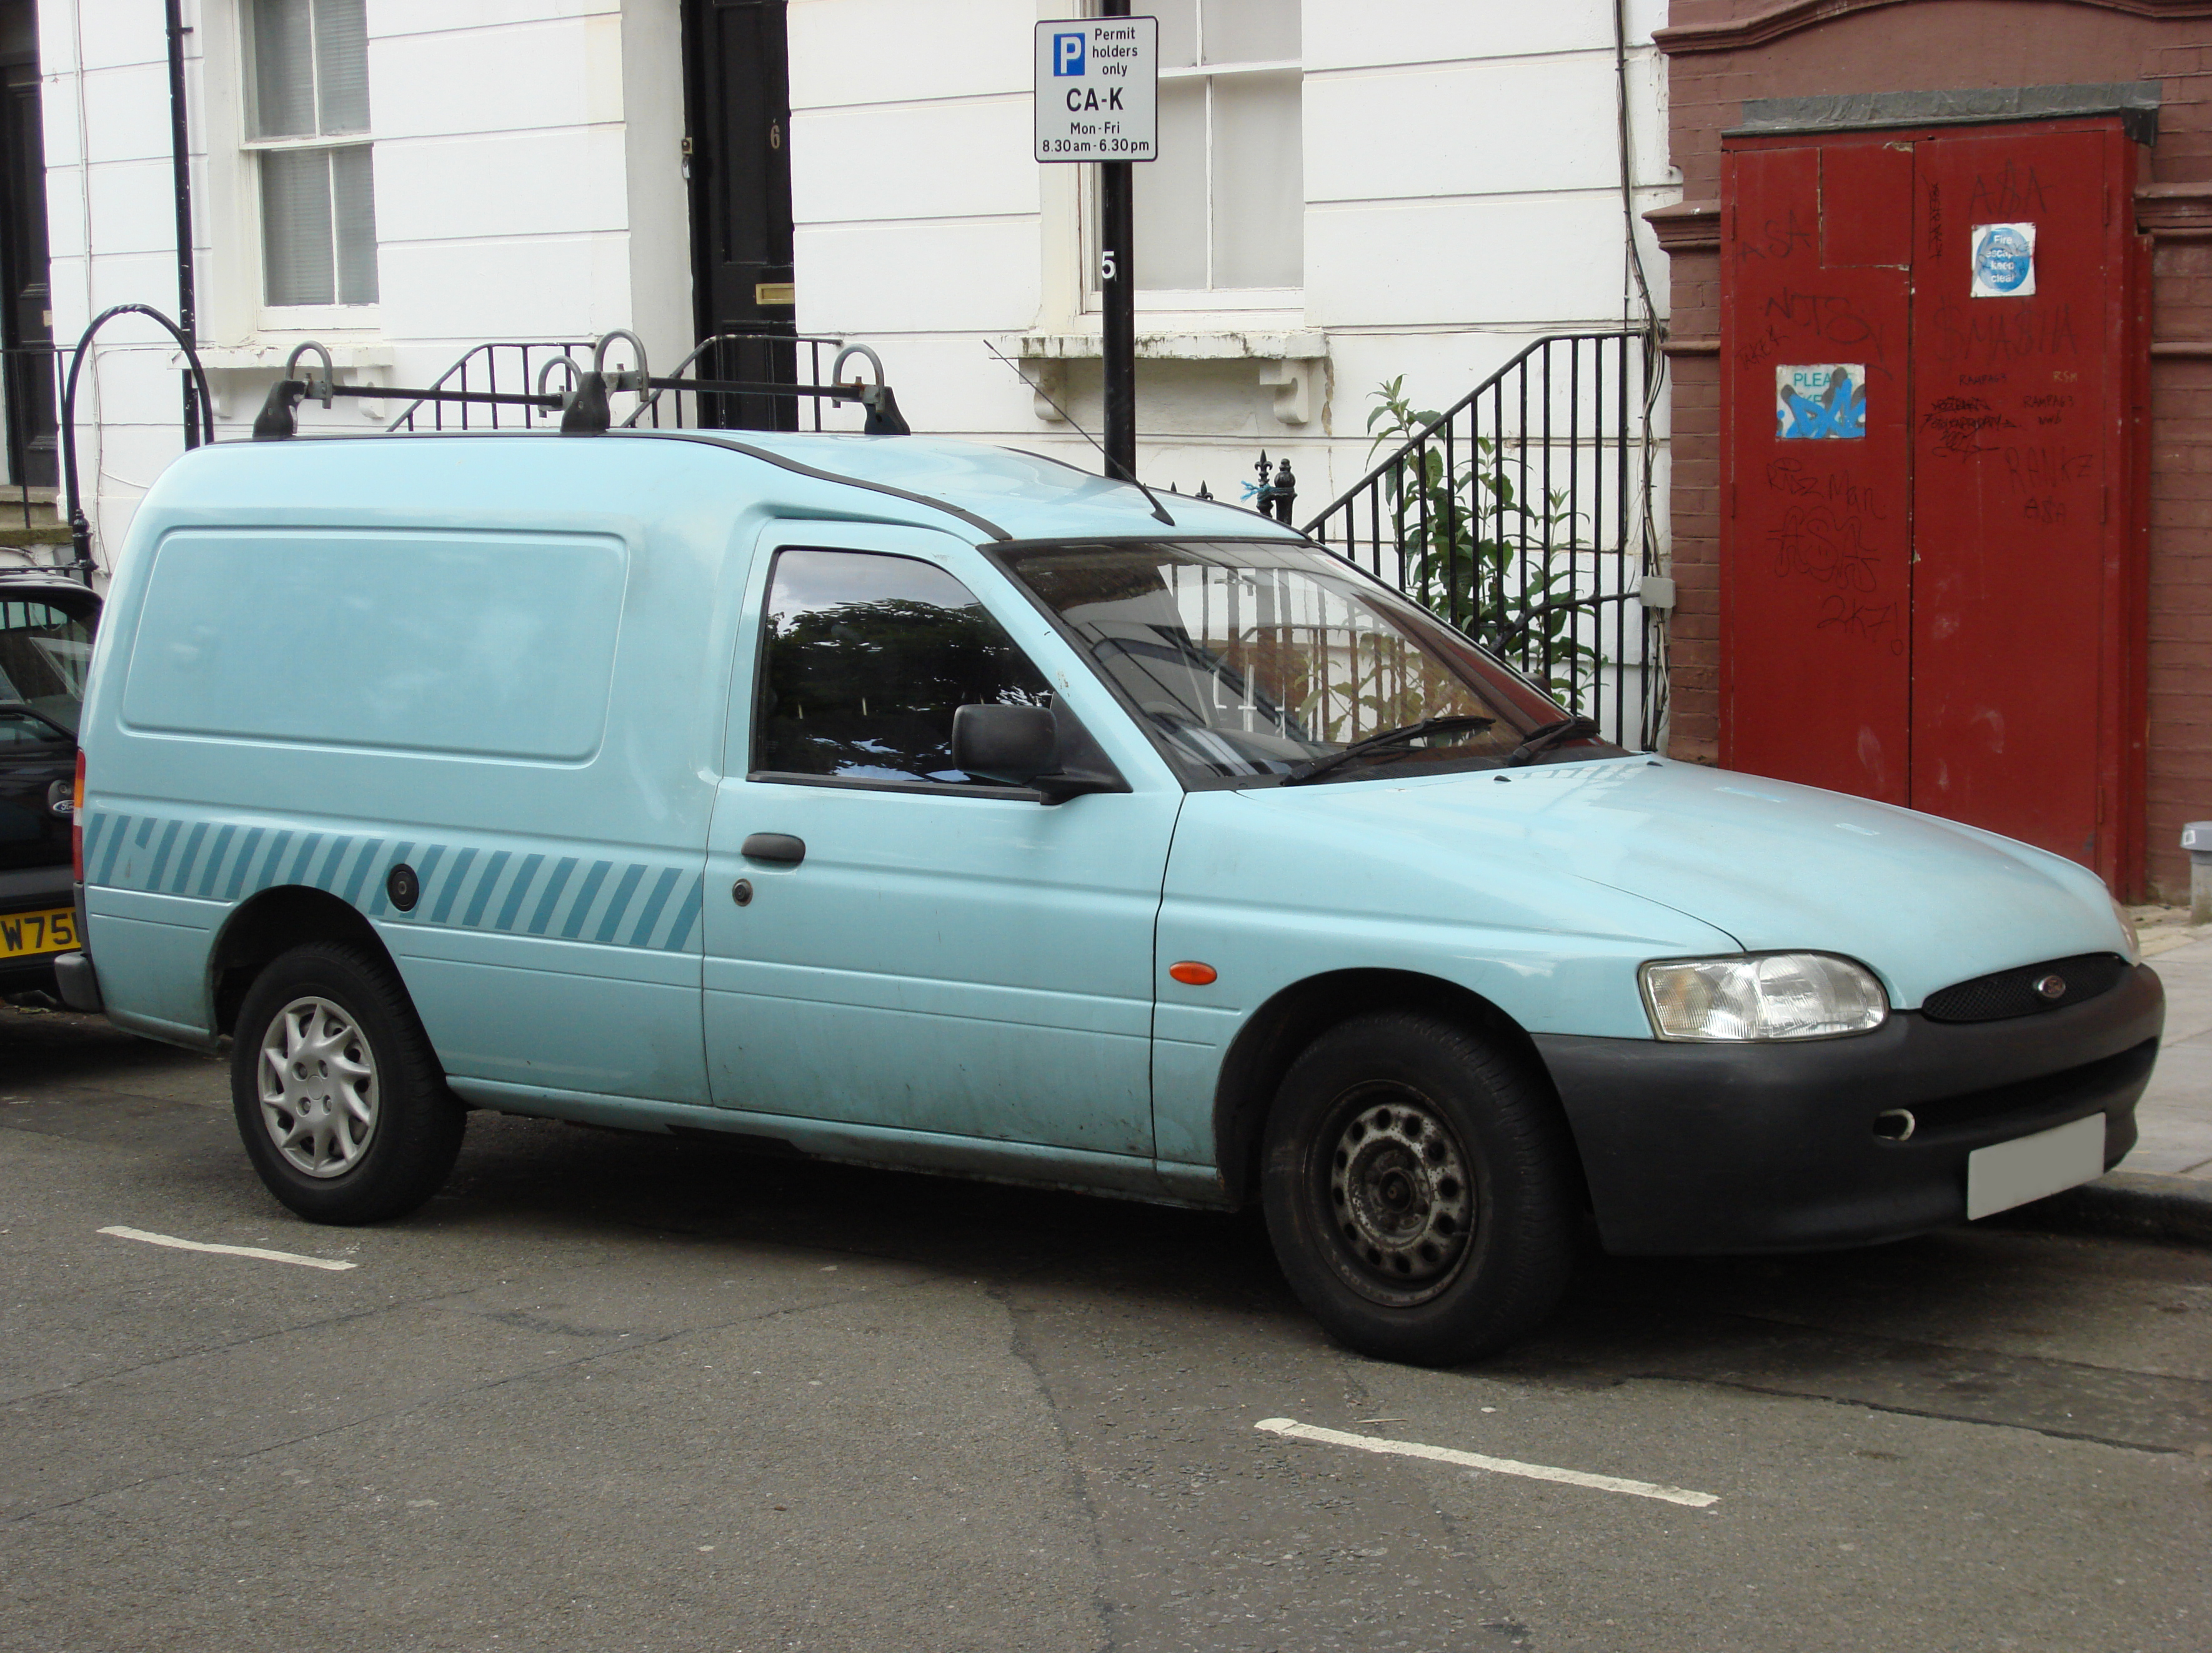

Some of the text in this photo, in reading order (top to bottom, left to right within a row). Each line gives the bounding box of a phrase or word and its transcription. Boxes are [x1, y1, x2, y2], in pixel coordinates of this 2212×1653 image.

[1095, 27, 1135, 41] Permit
[1060, 37, 1082, 74] P
[1092, 44, 1138, 58] holders
[1102, 62, 1128, 77] only
[1066, 87, 1123, 112] CA-K
[770, 125, 780, 149] 6
[1994, 234, 2013, 244] Fire
[1986, 250, 2018, 259] escap
[1102, 251, 1116, 279] 5
[1991, 261, 2015, 270] keep
[1991, 274, 2015, 283] clear
